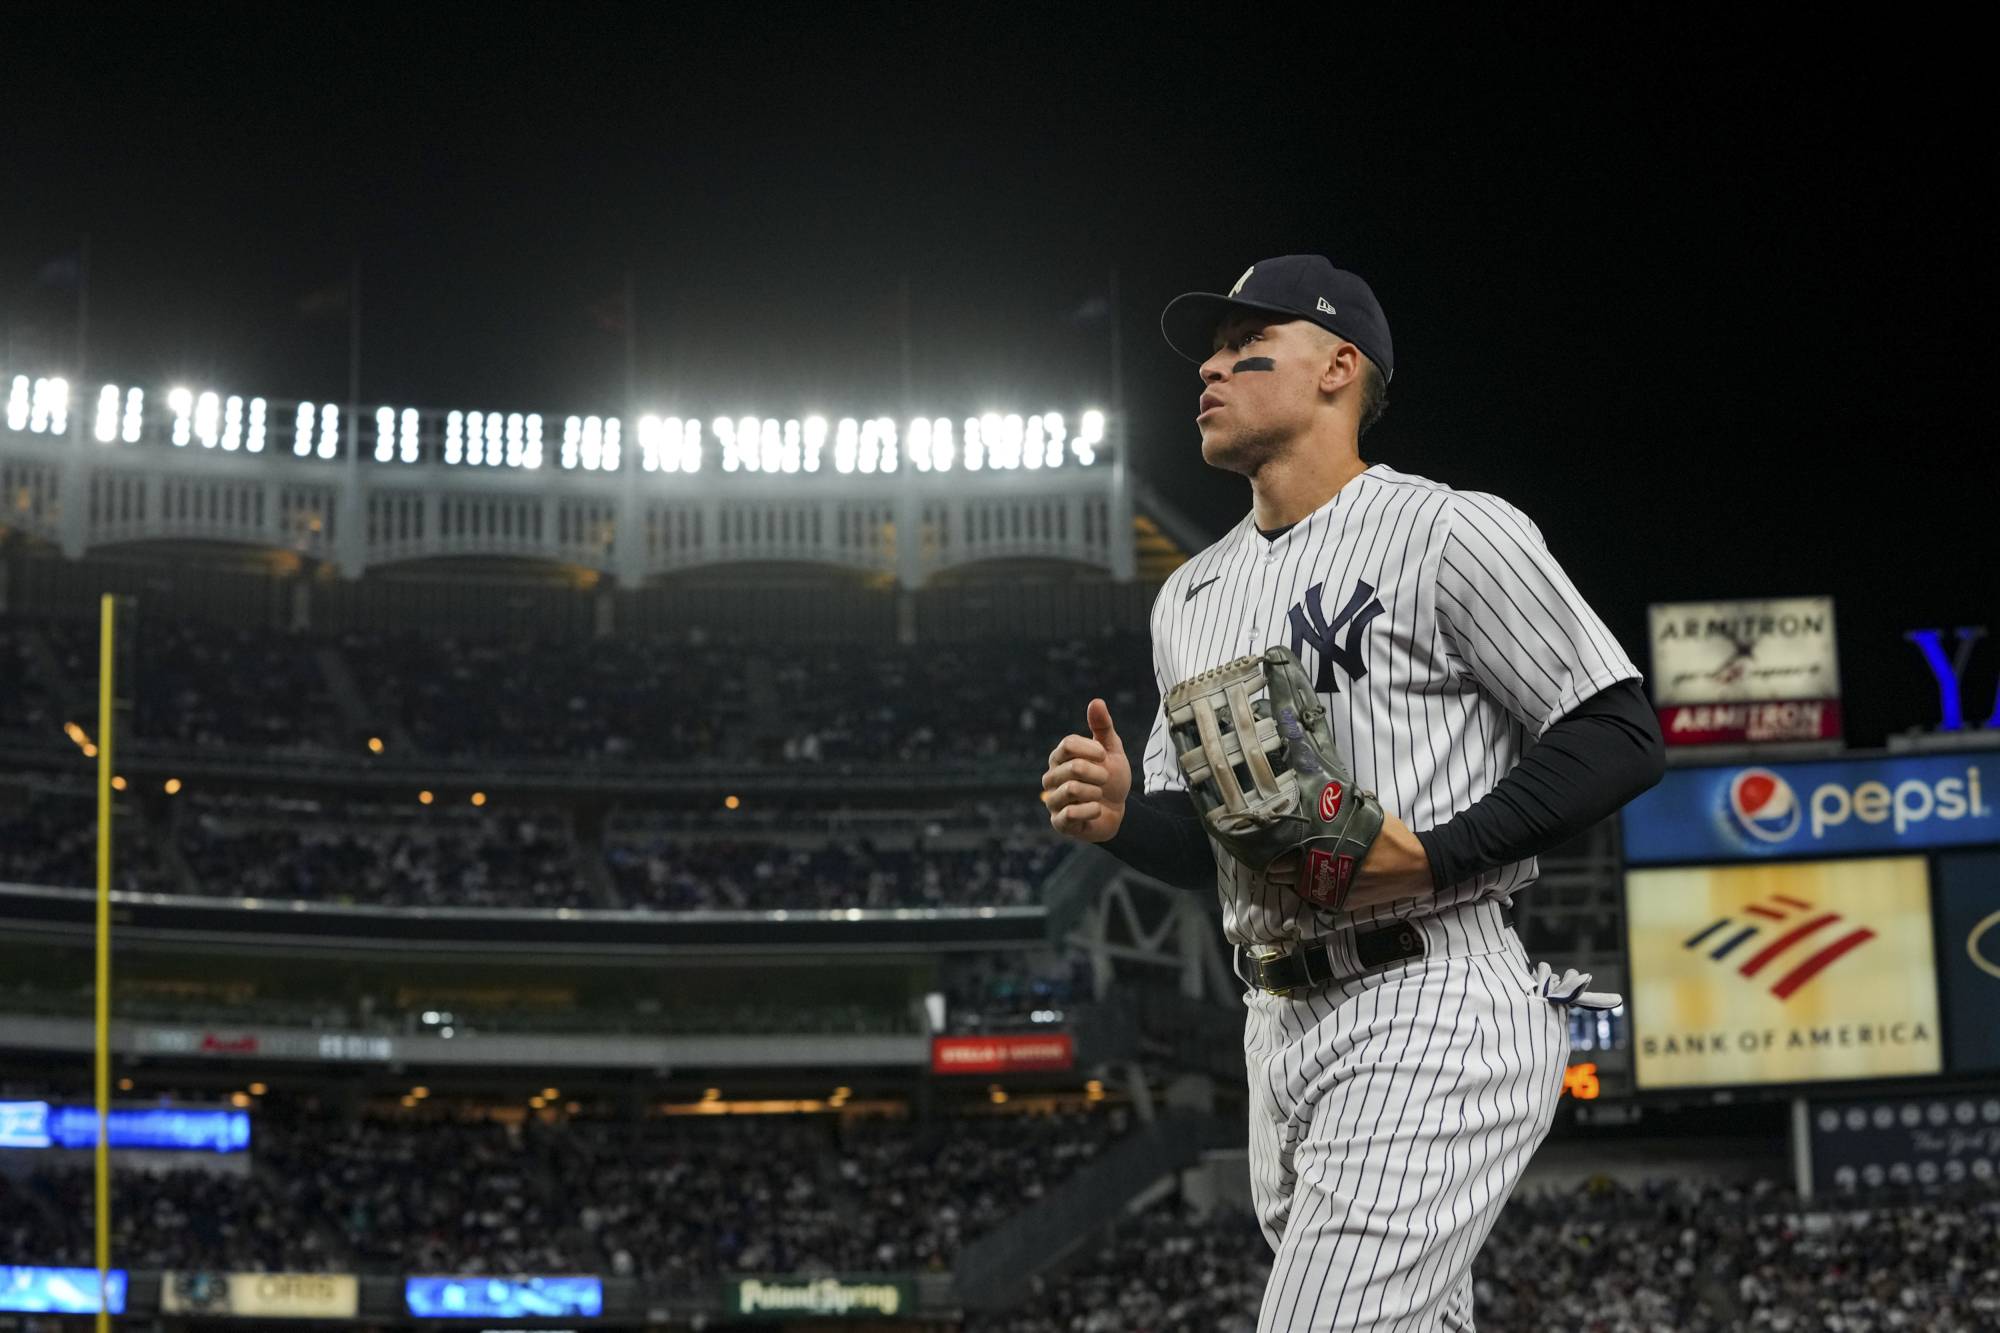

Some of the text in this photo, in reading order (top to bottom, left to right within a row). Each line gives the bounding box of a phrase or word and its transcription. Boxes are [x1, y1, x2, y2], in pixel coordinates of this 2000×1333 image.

[1288, 579, 1385, 693] NY
[1660, 614, 1823, 640] ARMITRON
[1903, 625, 2000, 731] Y
[1810, 767, 1982, 839] pepsi
[1642, 1022, 1929, 1056] BANK OF AMERICA
